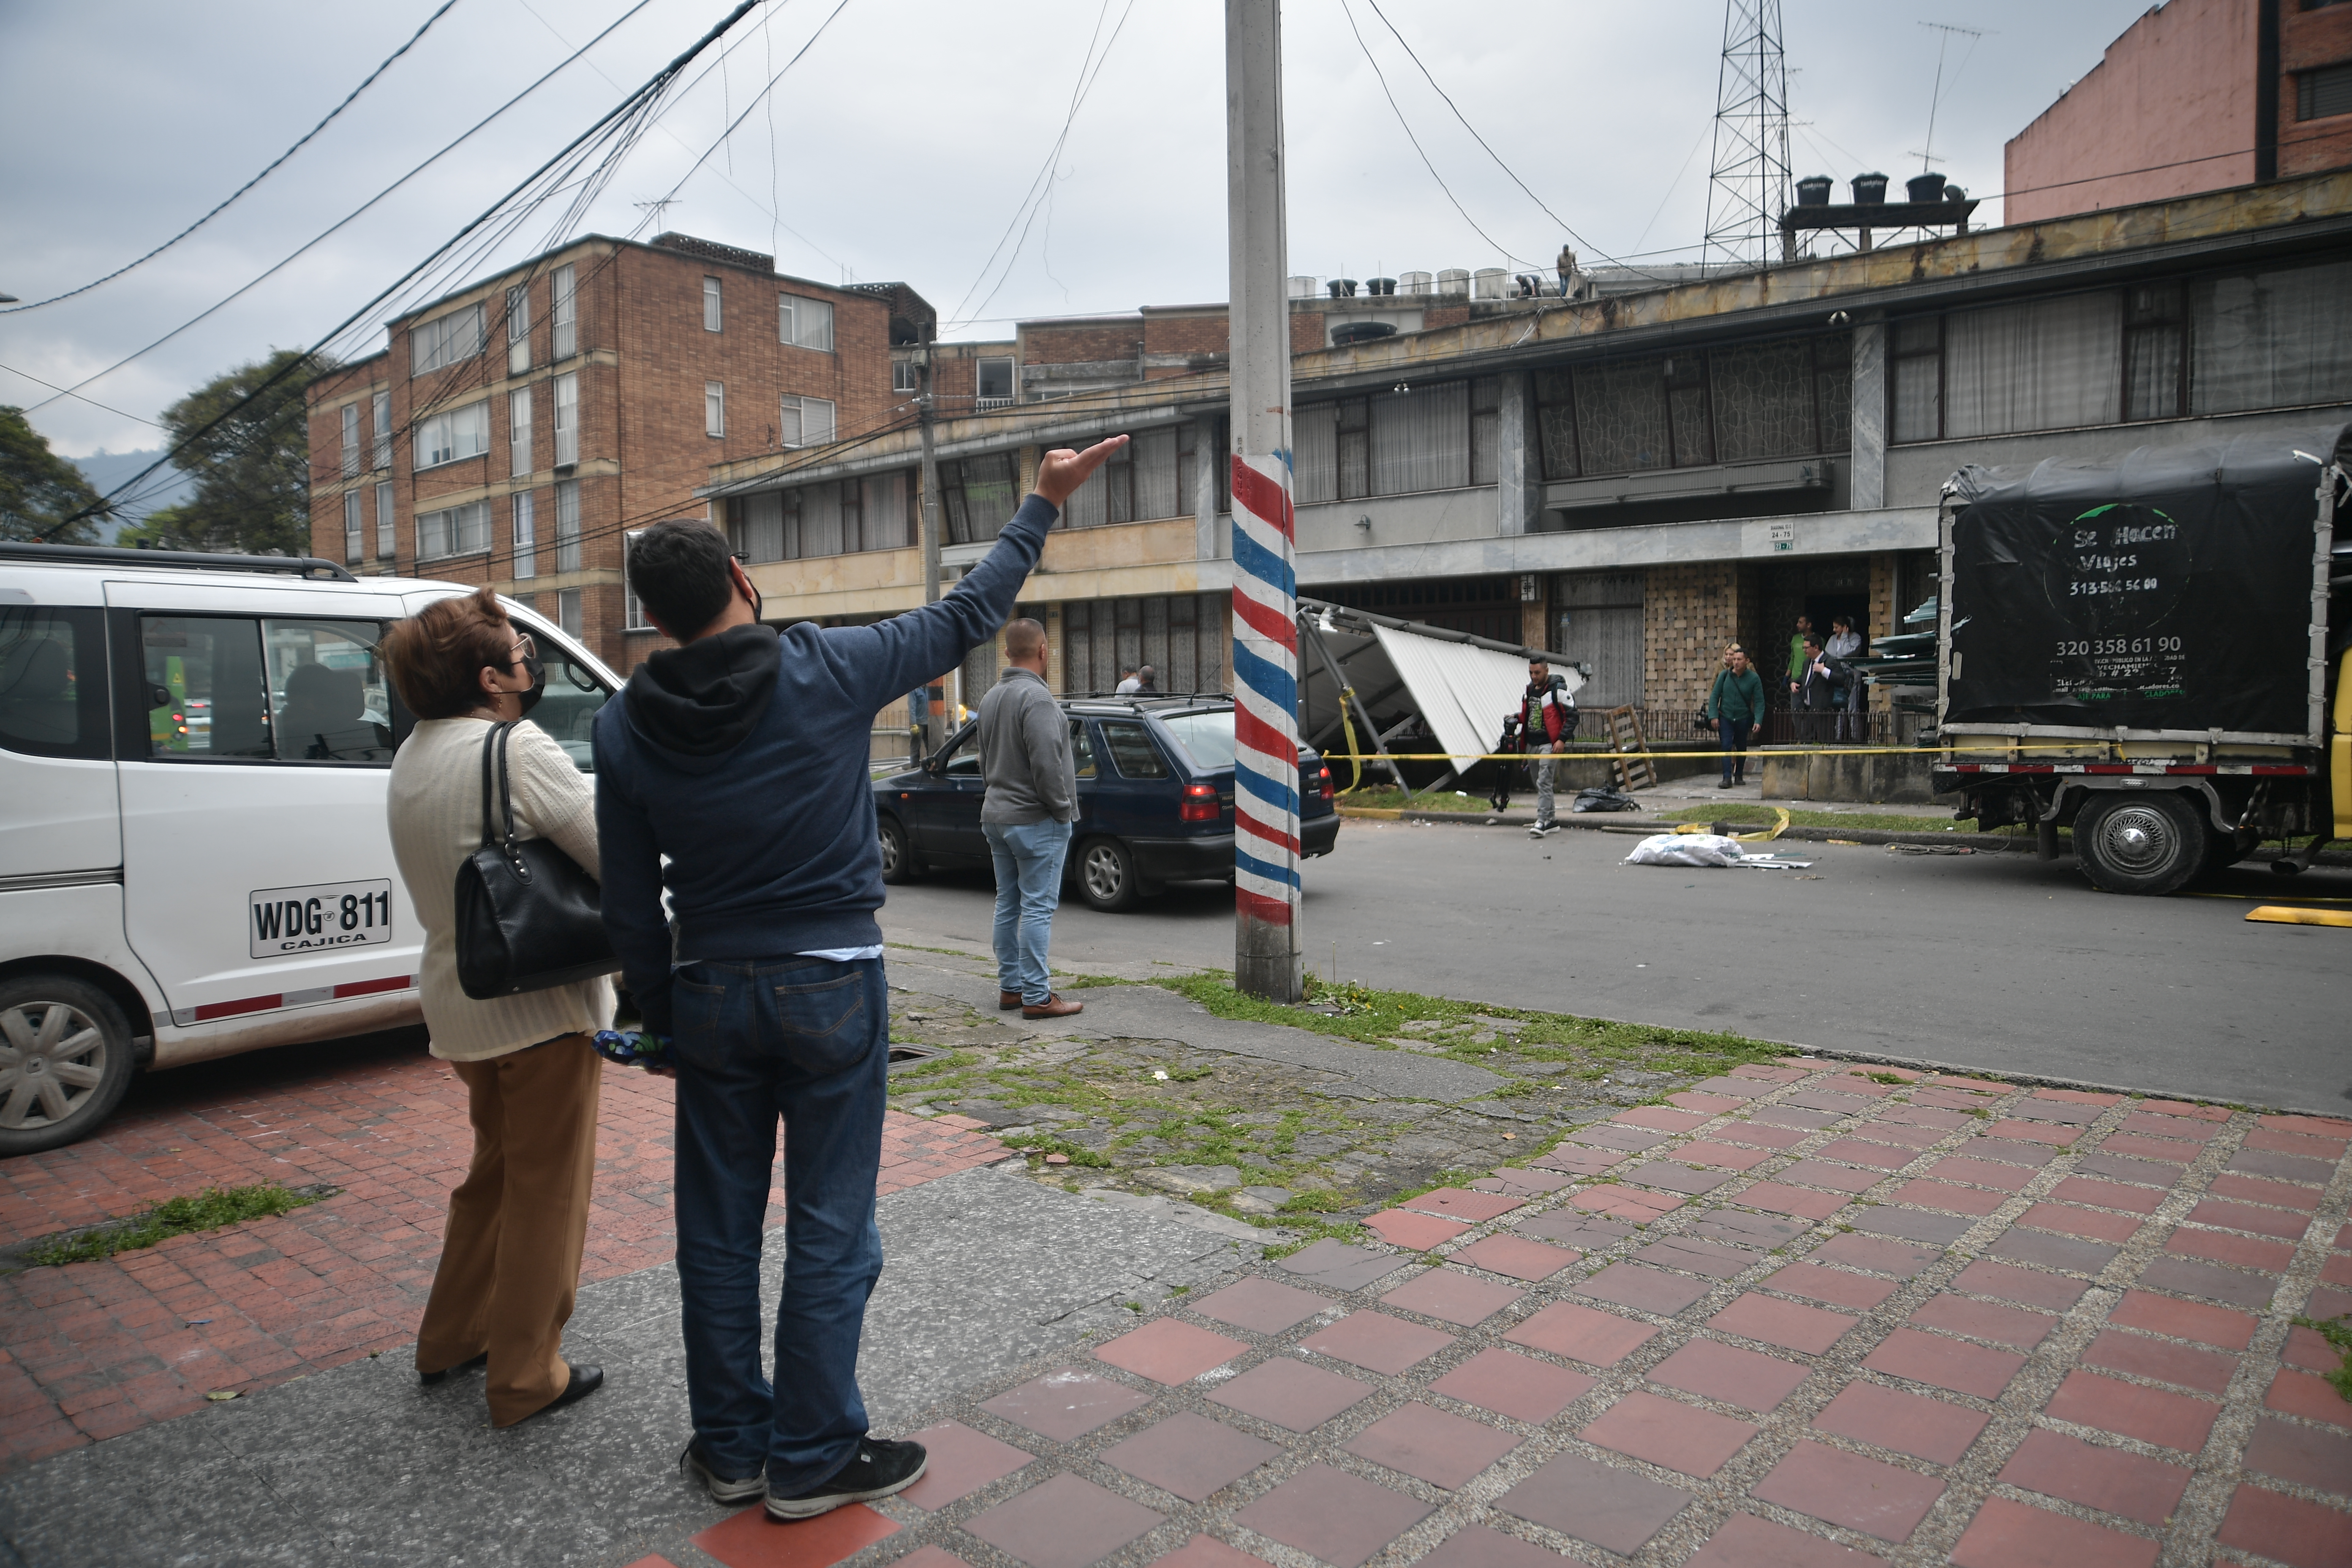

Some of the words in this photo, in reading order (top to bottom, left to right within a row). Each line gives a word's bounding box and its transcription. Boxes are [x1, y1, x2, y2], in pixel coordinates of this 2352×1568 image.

[2074, 530, 2098, 549] Se
[2115, 524, 2177, 545] Hacen
[2056, 641, 2089, 656] 320
[2094, 639, 2127, 655] 358
[2132, 638, 2151, 653] 61
[2159, 637, 2181, 652] 90
[253, 897, 322, 941] WDG
[339, 890, 388, 931] 811
[280, 933, 367, 951] CAJICA
